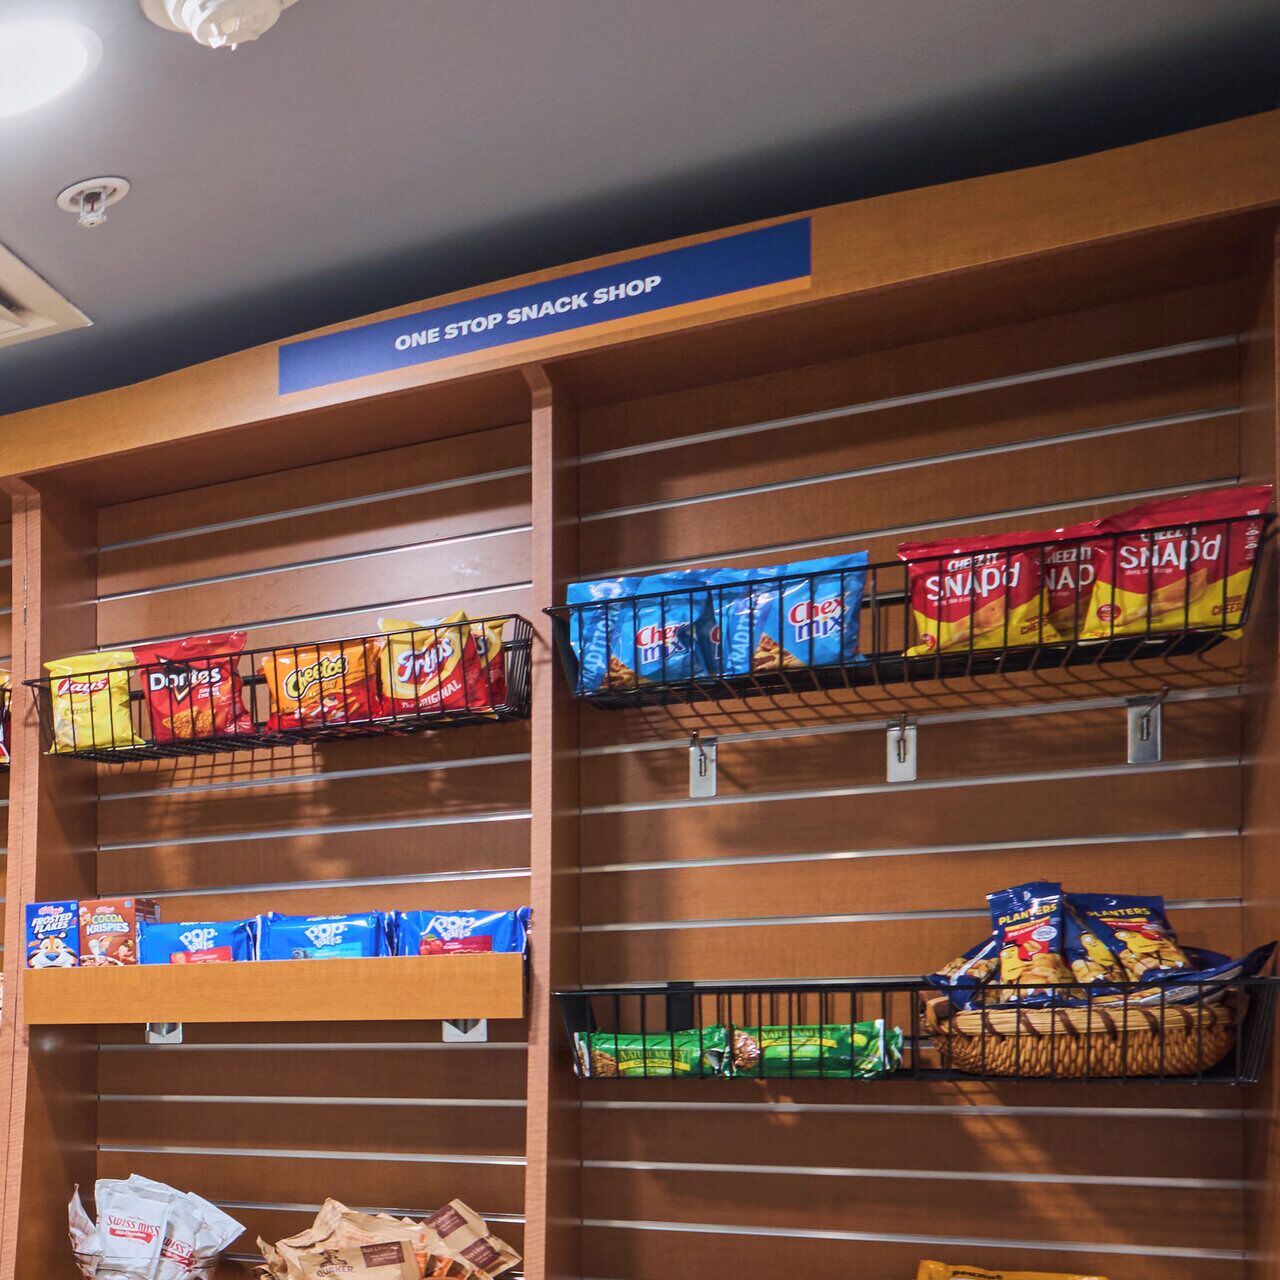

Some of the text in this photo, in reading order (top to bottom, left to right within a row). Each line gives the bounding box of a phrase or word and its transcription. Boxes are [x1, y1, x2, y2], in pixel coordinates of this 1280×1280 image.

[395, 275, 662, 351] ONE STOP SNACK SHOP
[789, 596, 848, 625] Chex
[796, 615, 844, 643] mix
[642, 641, 686, 664] mix
[286, 656, 346, 699] Cheetos
[31, 912, 73, 927] FROSTED
[92, 914, 124, 924] COCOA
[999, 903, 1057, 926] PLANTERS
[34, 920, 69, 934] FLAKES
[86, 922, 130, 936] KRISPIES
[316, 1265, 354, 1278] QUAKER
